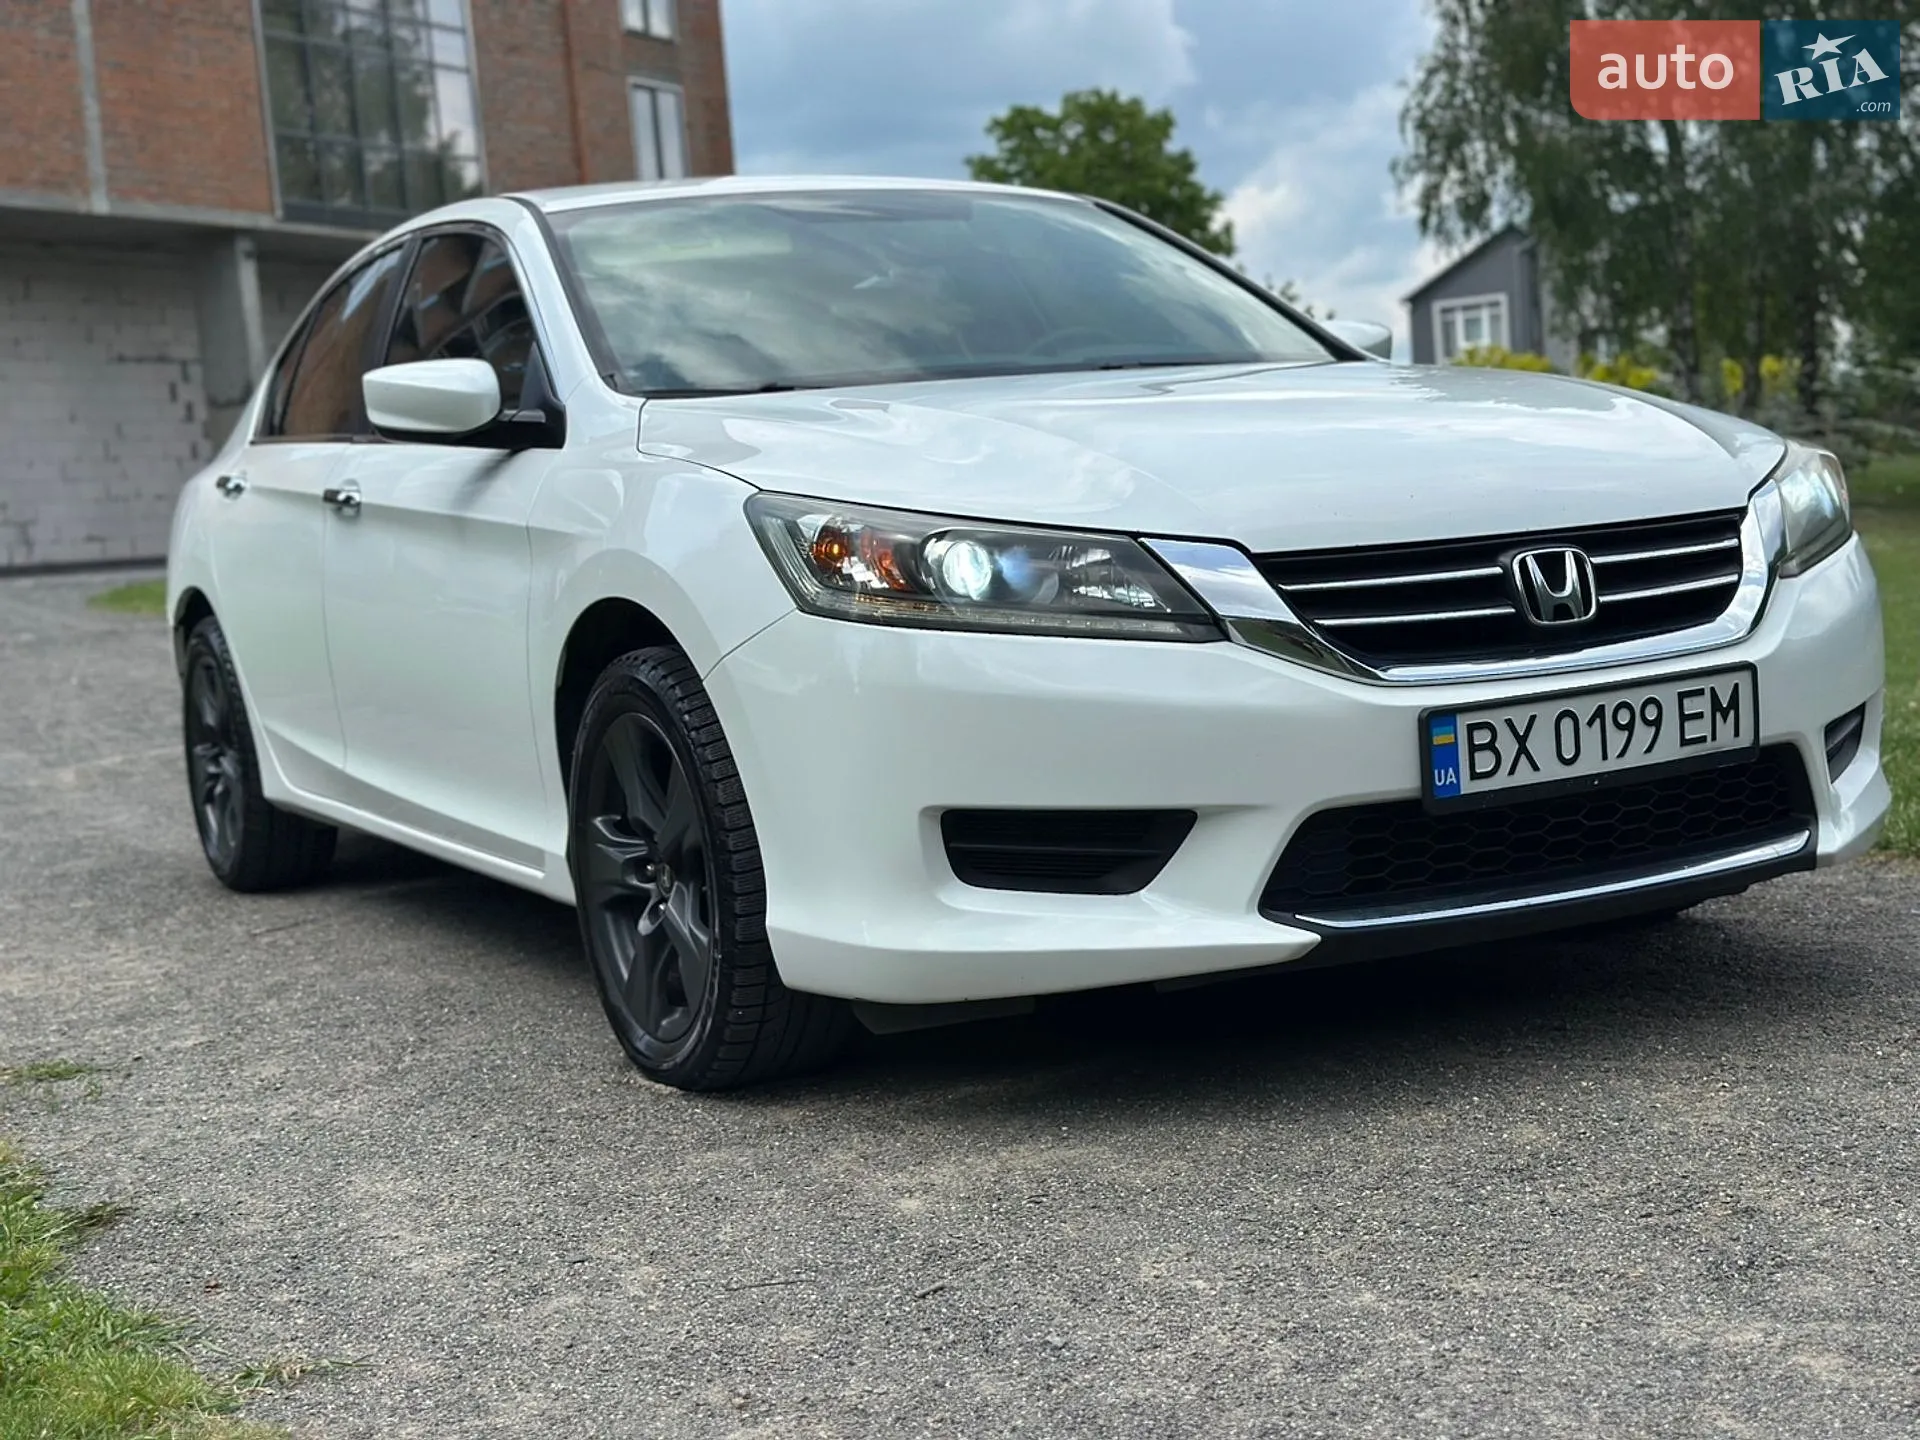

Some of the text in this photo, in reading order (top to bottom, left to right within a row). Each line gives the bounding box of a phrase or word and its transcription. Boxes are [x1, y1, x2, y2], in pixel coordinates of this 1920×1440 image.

[1466, 682, 1740, 781] BX 0199 EM
[1434, 767, 1457, 786] UA
